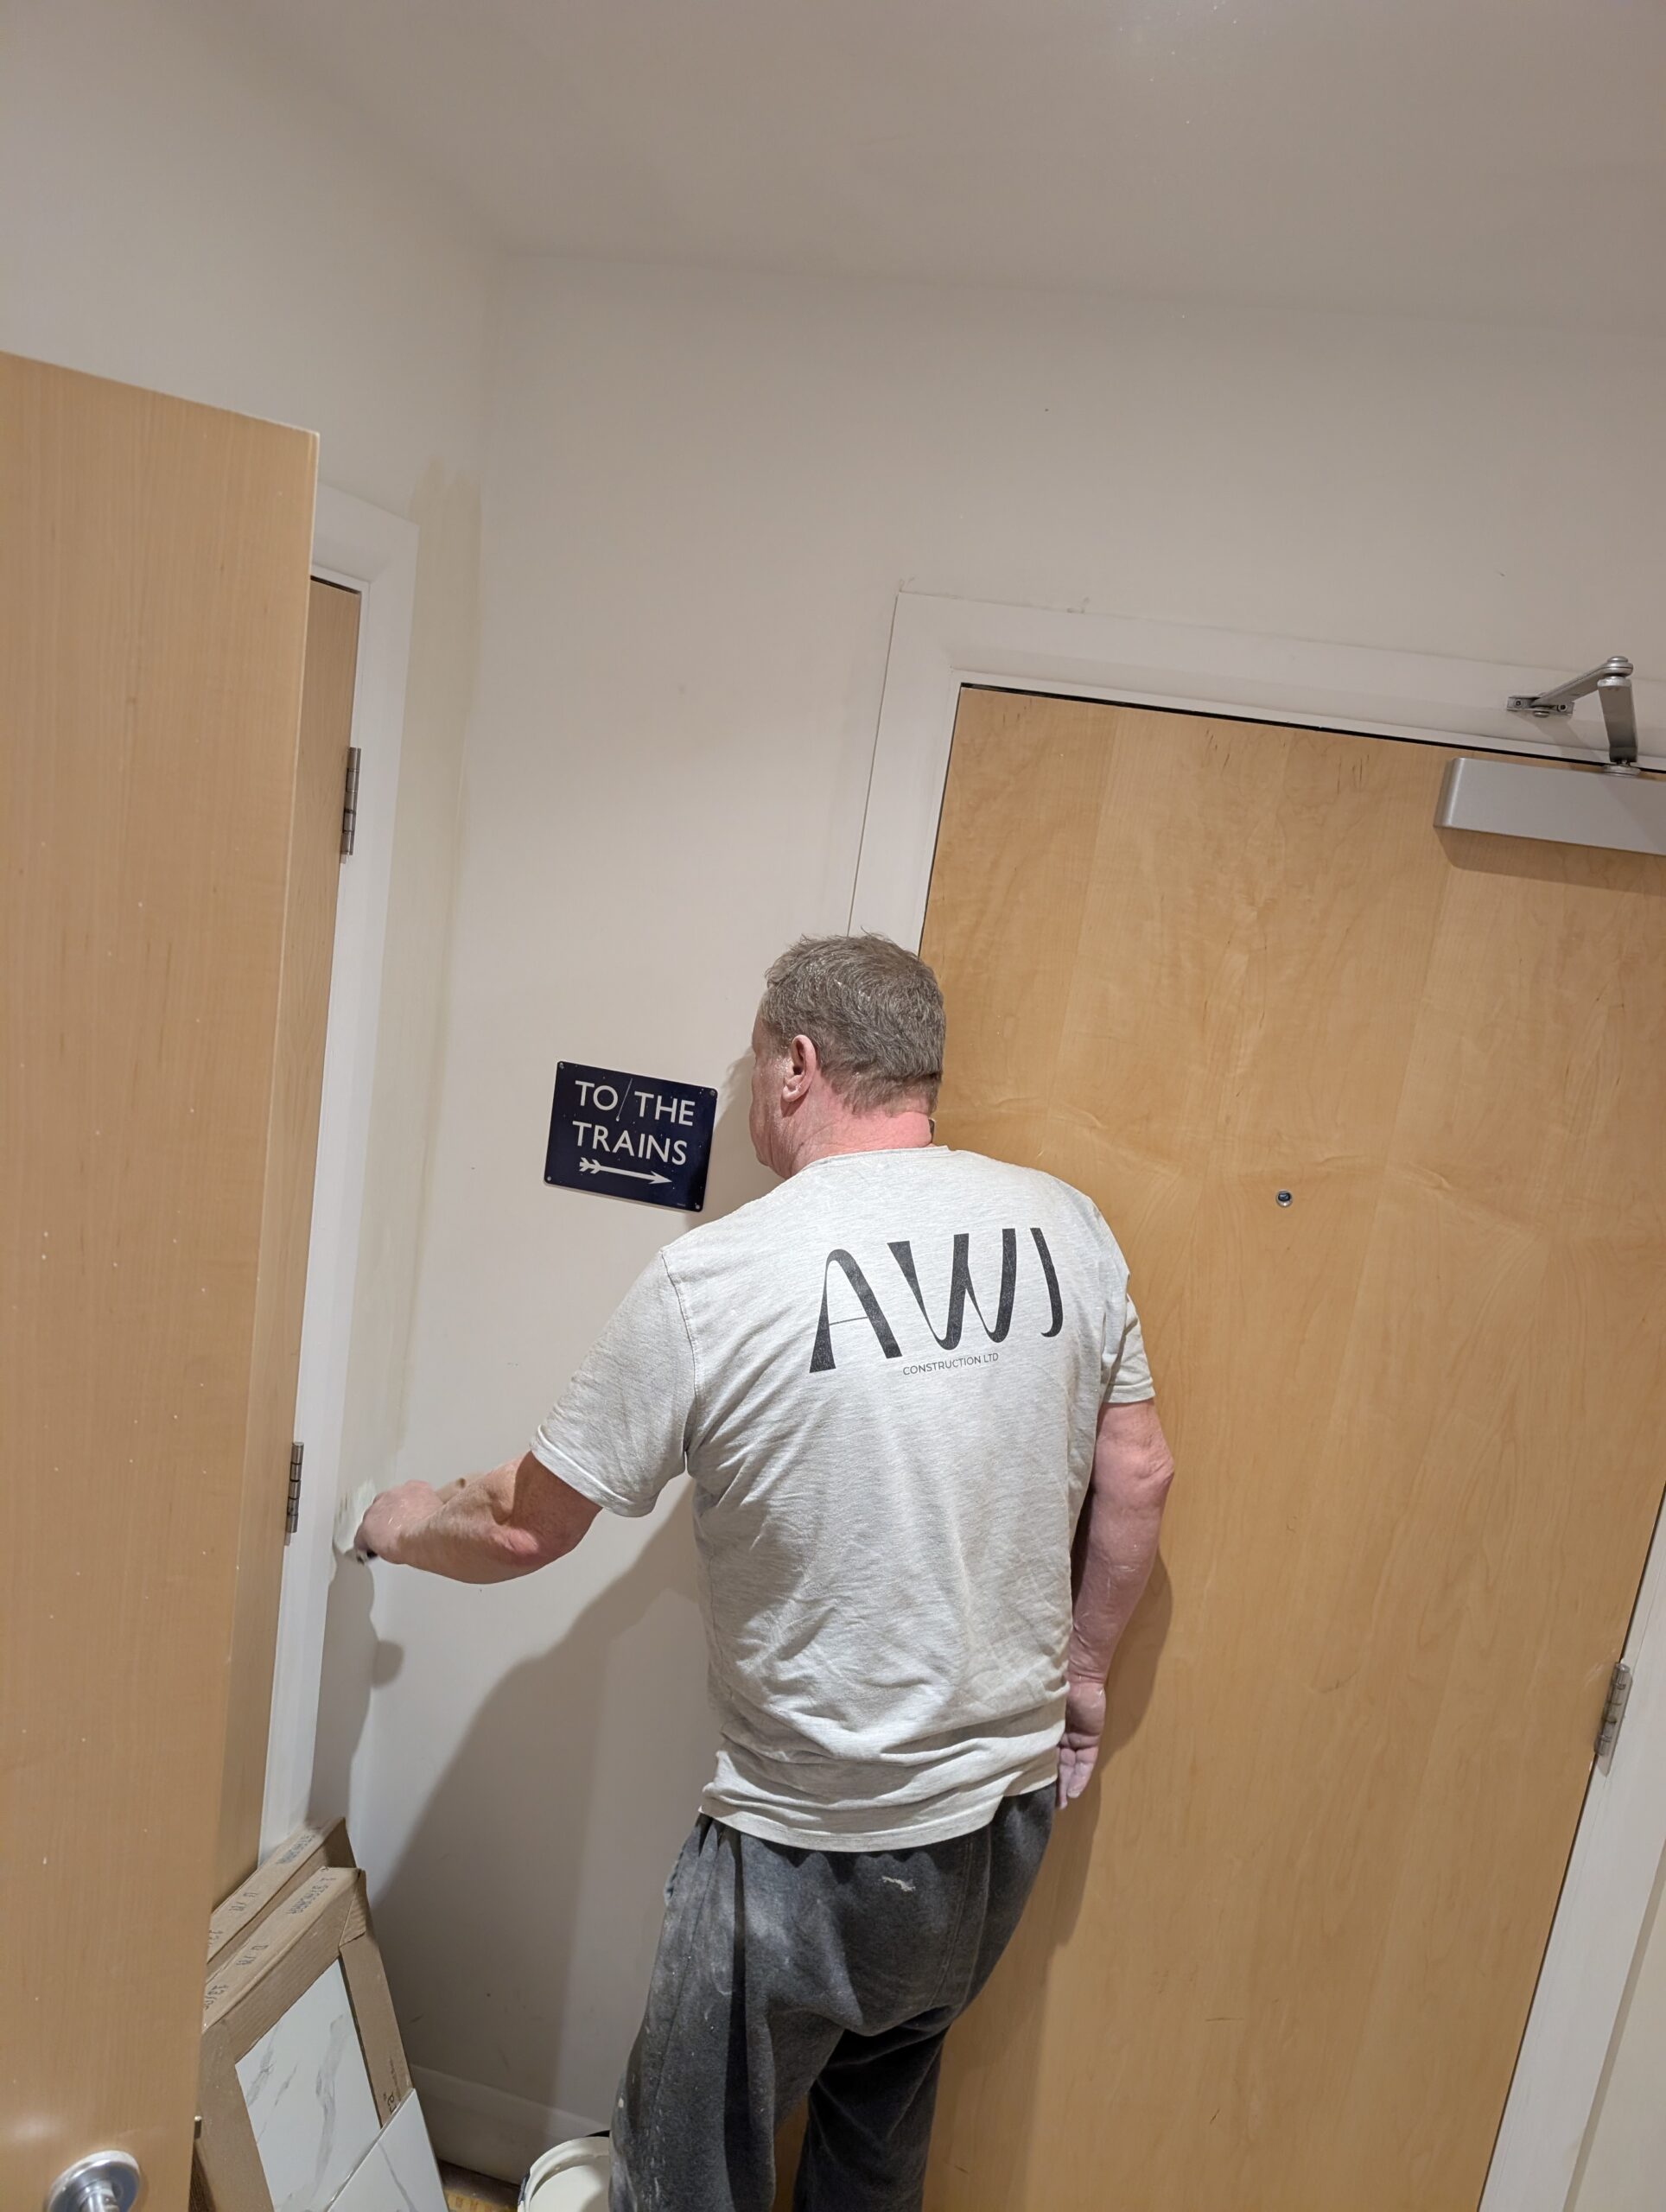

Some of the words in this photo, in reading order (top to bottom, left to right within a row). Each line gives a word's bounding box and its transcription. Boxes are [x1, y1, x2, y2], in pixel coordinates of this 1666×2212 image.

[575, 1080, 619, 1111] TO
[634, 1090, 696, 1127] THE
[572, 1121, 688, 1166] TRAINS
[809, 1227, 1064, 1374] AWJ
[903, 1357, 982, 1376] CONSTRUCTION
[982, 1352, 999, 1363] LTD
